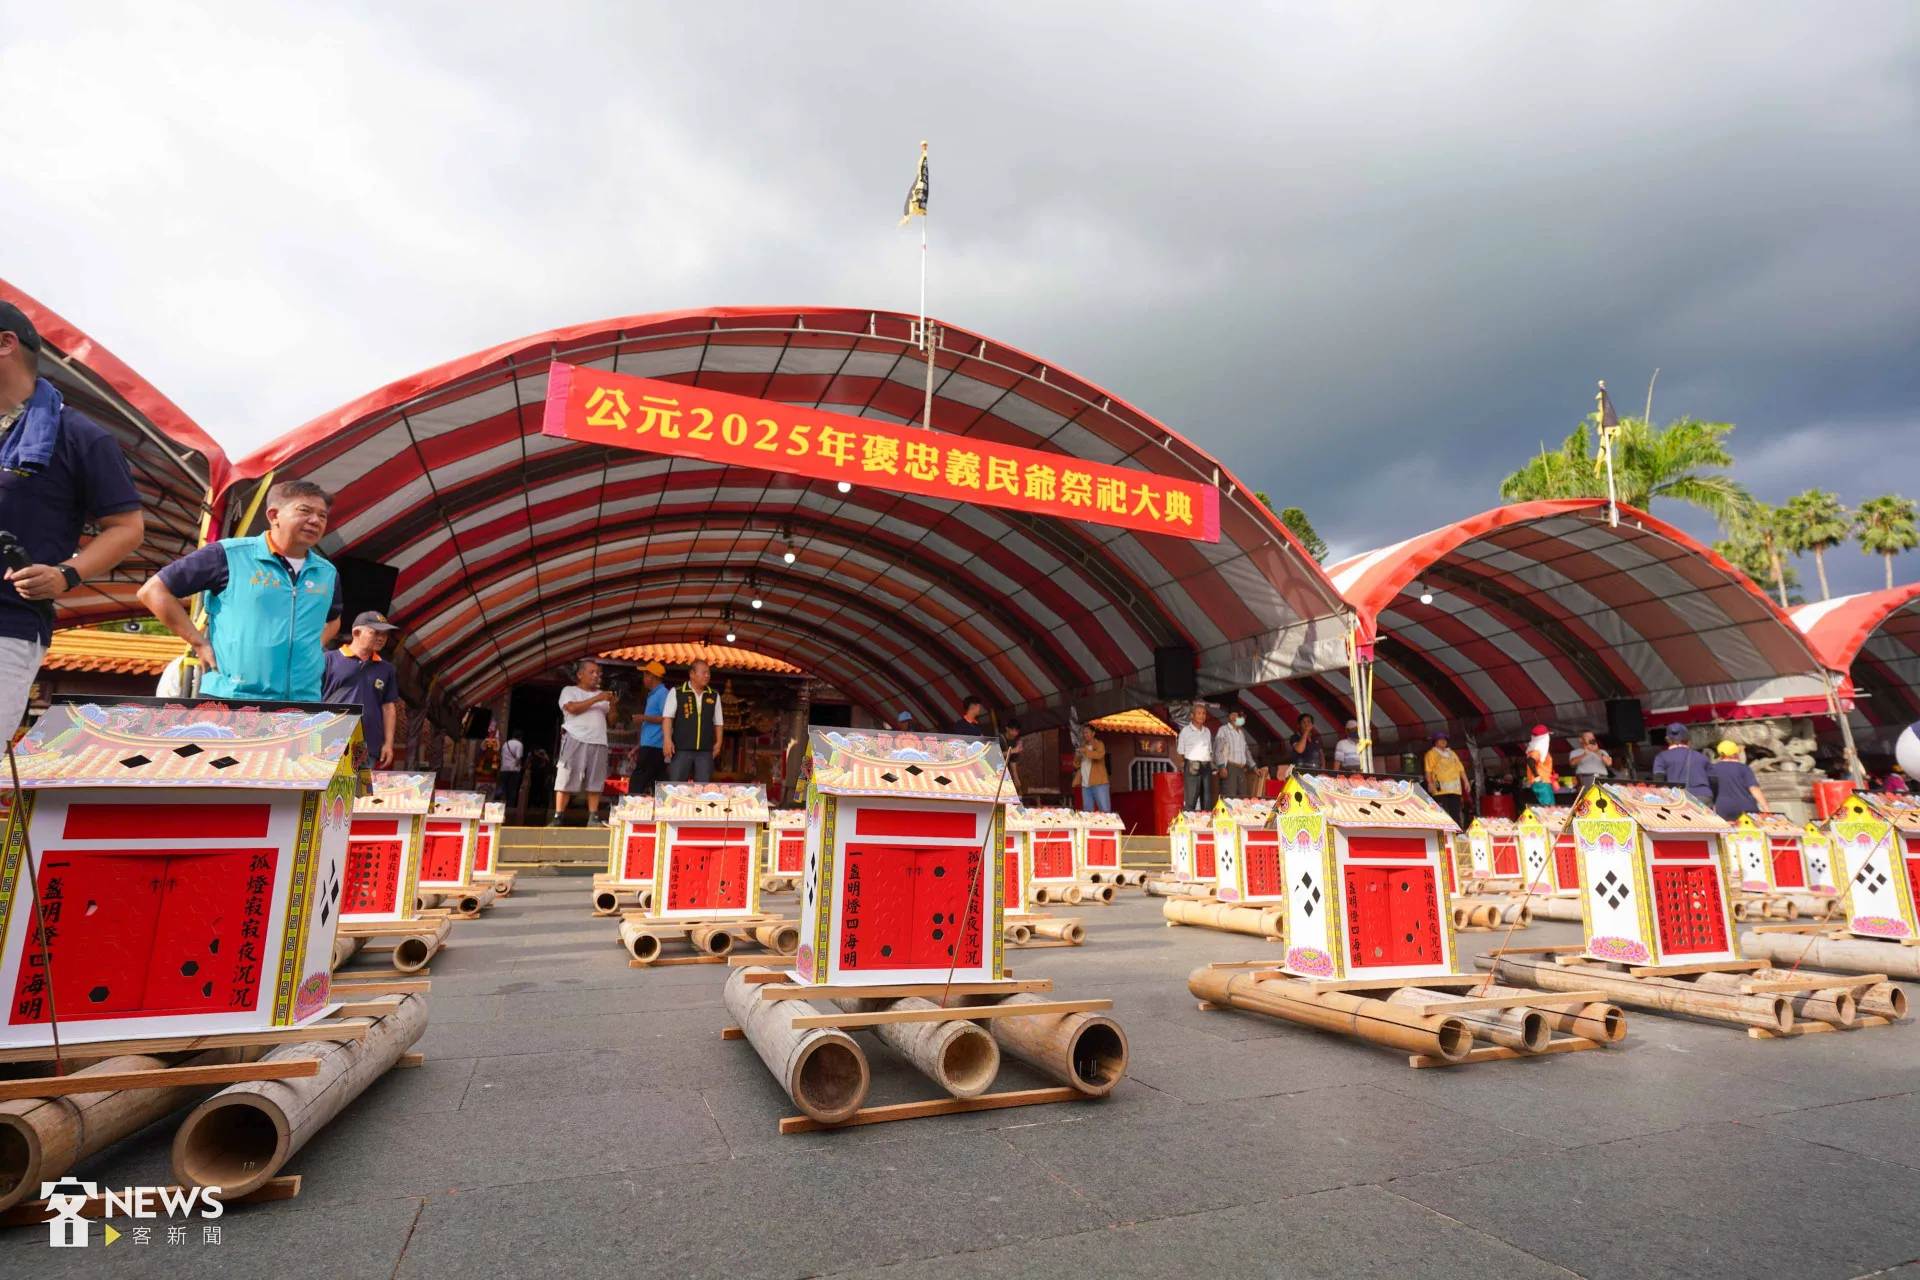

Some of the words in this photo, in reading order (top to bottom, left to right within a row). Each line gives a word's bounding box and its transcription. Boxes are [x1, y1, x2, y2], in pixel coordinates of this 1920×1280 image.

[584, 387, 1194, 526] 公元2025年褒忠義民爺祭祀大典
[18, 862, 71, 1020] 一盞明燈四海明
[229, 853, 272, 1008] 孤燈寂寂夜沉沉
[843, 851, 863, 968] 一盞明燈四海明
